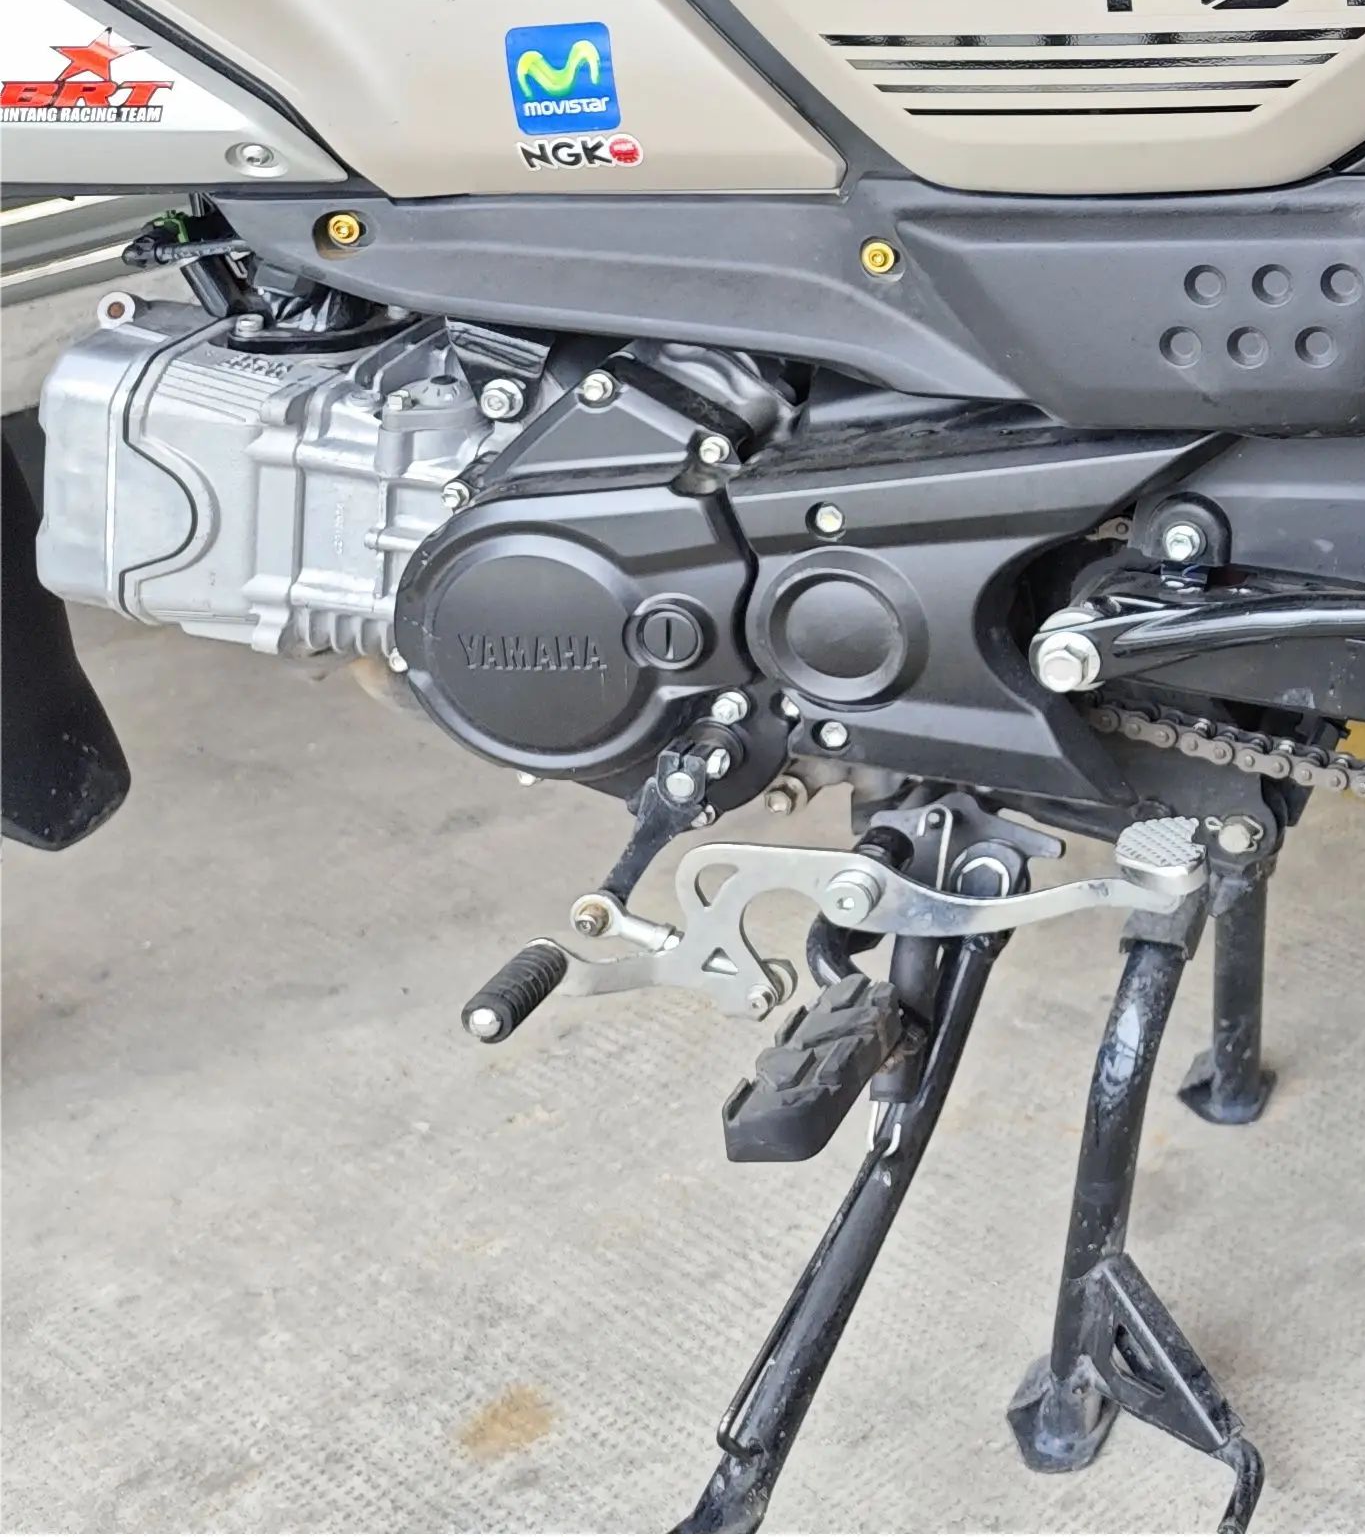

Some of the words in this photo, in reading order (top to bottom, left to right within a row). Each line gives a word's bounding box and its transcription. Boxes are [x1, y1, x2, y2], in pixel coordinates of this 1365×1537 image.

[0, 80, 175, 108] BRT
[523, 96, 610, 117] movistar
[60, 107, 118, 123] RACING
[120, 107, 162, 123] TEAM
[519, 141, 613, 169] NGK
[457, 633, 607, 671] YAMAHA
